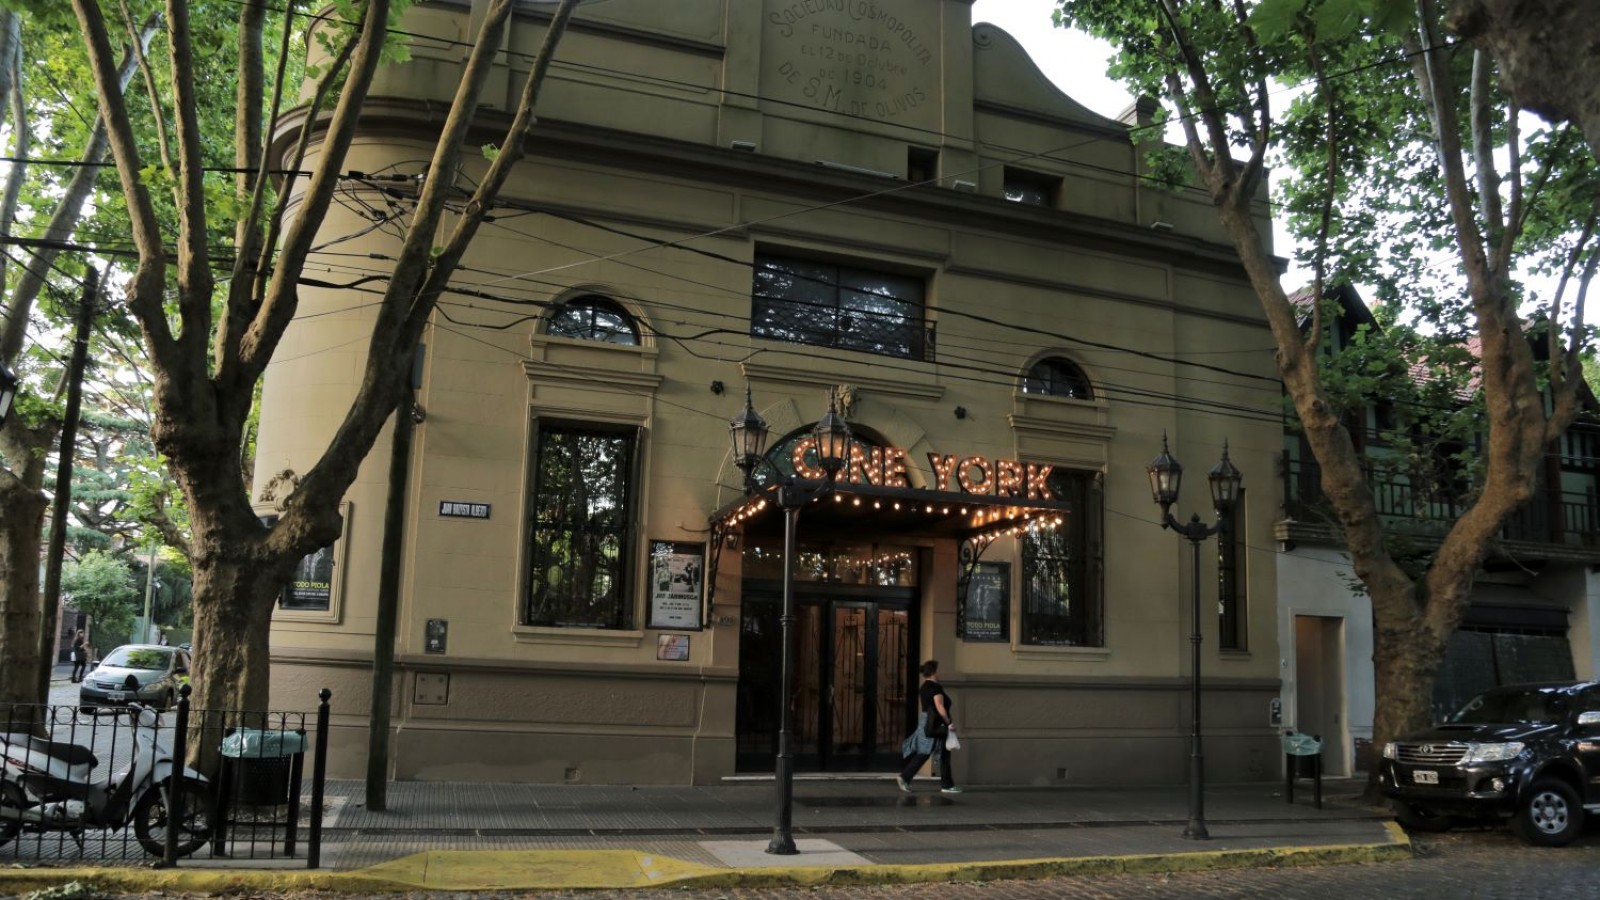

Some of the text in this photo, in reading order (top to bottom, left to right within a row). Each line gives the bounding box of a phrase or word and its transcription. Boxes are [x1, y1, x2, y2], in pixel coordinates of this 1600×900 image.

[812, 24, 892, 52] FUNDADA
[801, 45, 817, 57] EL
[820, 46, 834, 60] 12
[778, 60, 801, 84] DE
[851, 101, 868, 117] DE
[876, 87, 926, 117] OLIVOS
[845, 69, 888, 90] 1904
[792, 437, 1055, 499] CNE YORK
